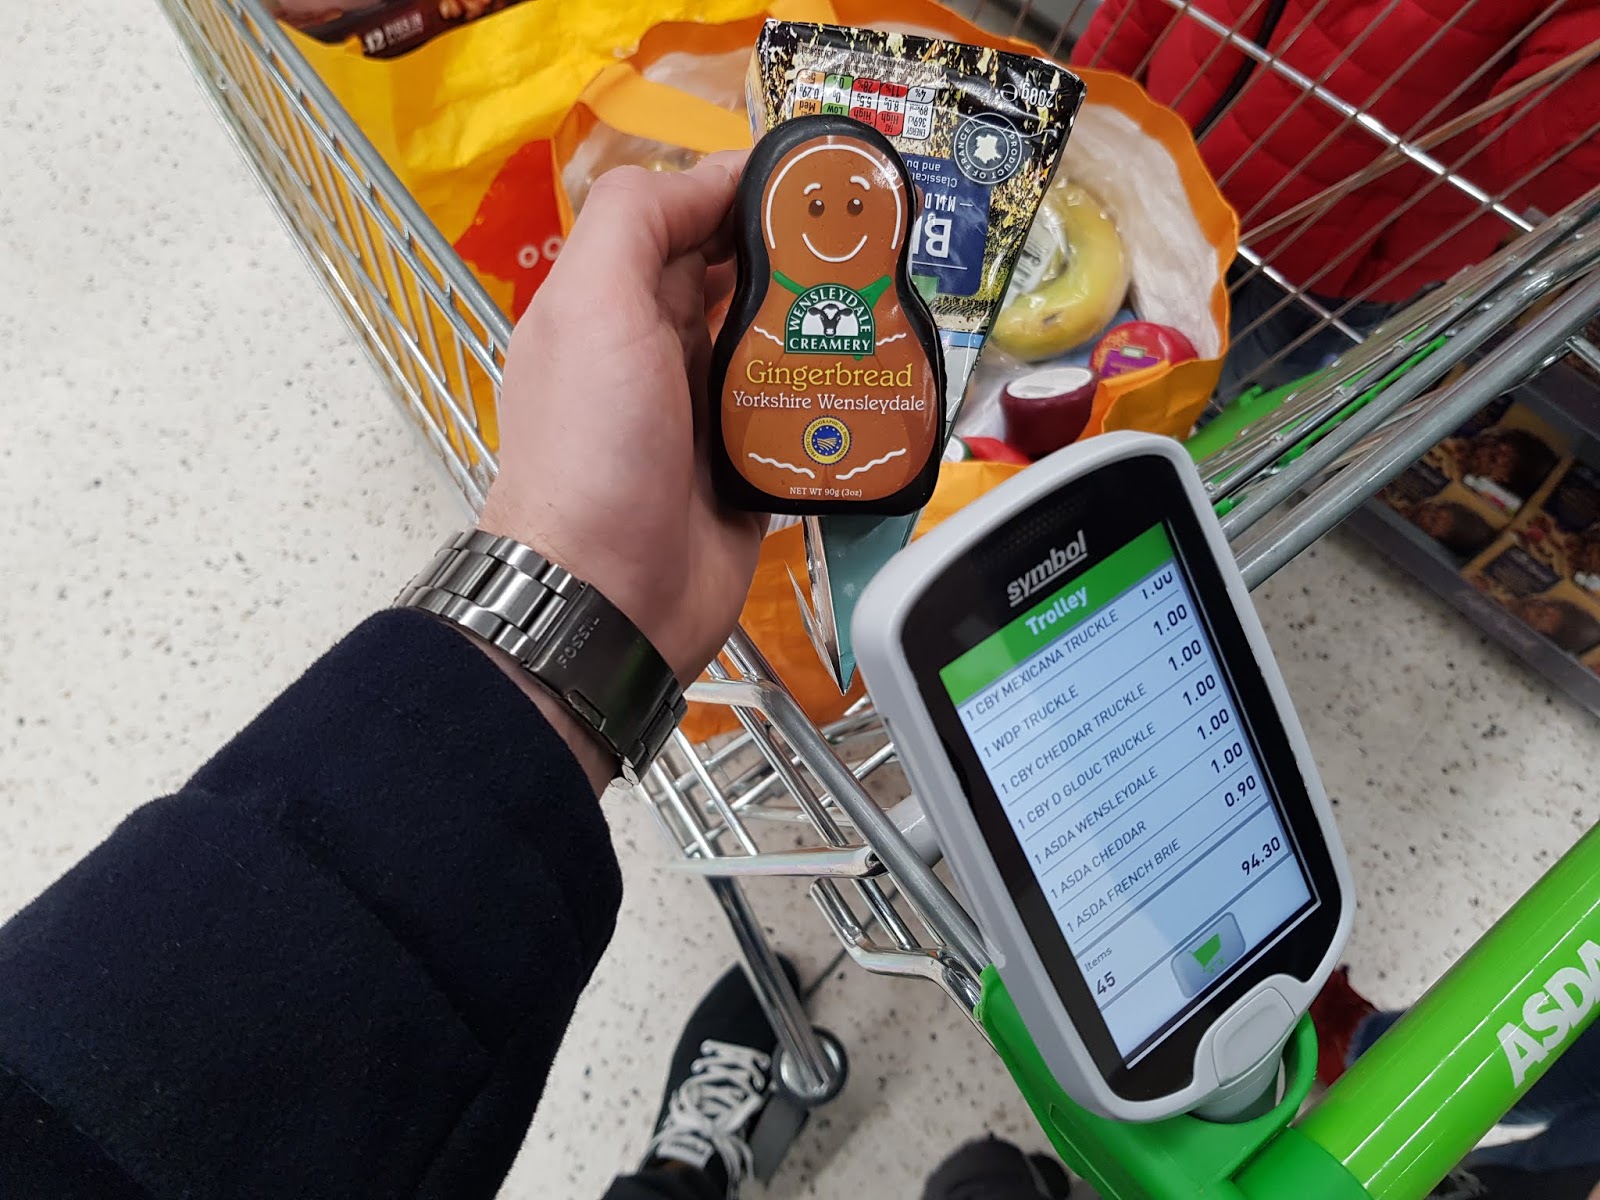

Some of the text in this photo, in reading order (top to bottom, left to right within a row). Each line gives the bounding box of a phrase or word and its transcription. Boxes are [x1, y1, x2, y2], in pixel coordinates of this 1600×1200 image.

[800, 84, 818, 99] 0.29g
[859, 80, 873, 92] 28%
[886, 84, 900, 96] 11%
[916, 89, 926, 101] 4%
[1021, 82, 1055, 108] 200g
[798, 102, 816, 112] Med
[857, 93, 872, 108] 5.5g
[884, 98, 898, 111] 8.0g
[854, 109, 871, 120] High
[882, 112, 898, 124] High
[908, 116, 926, 127] 369kJ
[906, 126, 926, 138] ENERGY
[958, 126, 1017, 179] PRODUCT OF FRANCE
[906, 160, 940, 171] and bu
[911, 172, 957, 188] Classical
[925, 193, 956, 212] MILD
[789, 288, 871, 332] WENSLEYDALE
[790, 338, 870, 350] CREAMERY
[746, 360, 912, 392] Gingerbread
[733, 390, 925, 414] Yorkshire Wensleydale
[790, 487, 862, 498] NET WT 90g (3oz)
[1007, 529, 1087, 600] symbol
[1025, 586, 1087, 635] Trolley
[557, 618, 600, 668] FOSS
[966, 571, 1173, 721] 1 CBY MEXICANA TRUCKLE 1.00
[984, 604, 1187, 758] 1 WDP TRUCKLE 1.00
[1001, 640, 1202, 794] 1 CBY CHEDDAR TRUCKLE 1.00
[1018, 674, 1216, 830] 1 CBY D GLOUC TRUCKLE 1.00
[1034, 708, 1230, 865] 1 ASDA WENSLEYDALE 1.00
[1050, 742, 1243, 899] 1 ASDA CHEDDAR 1.00
[1067, 775, 1256, 933] 1 ASDA FRENCH BRIE 0.90
[1084, 836, 1281, 972] Items 94.30
[1097, 971, 1116, 995] 45
